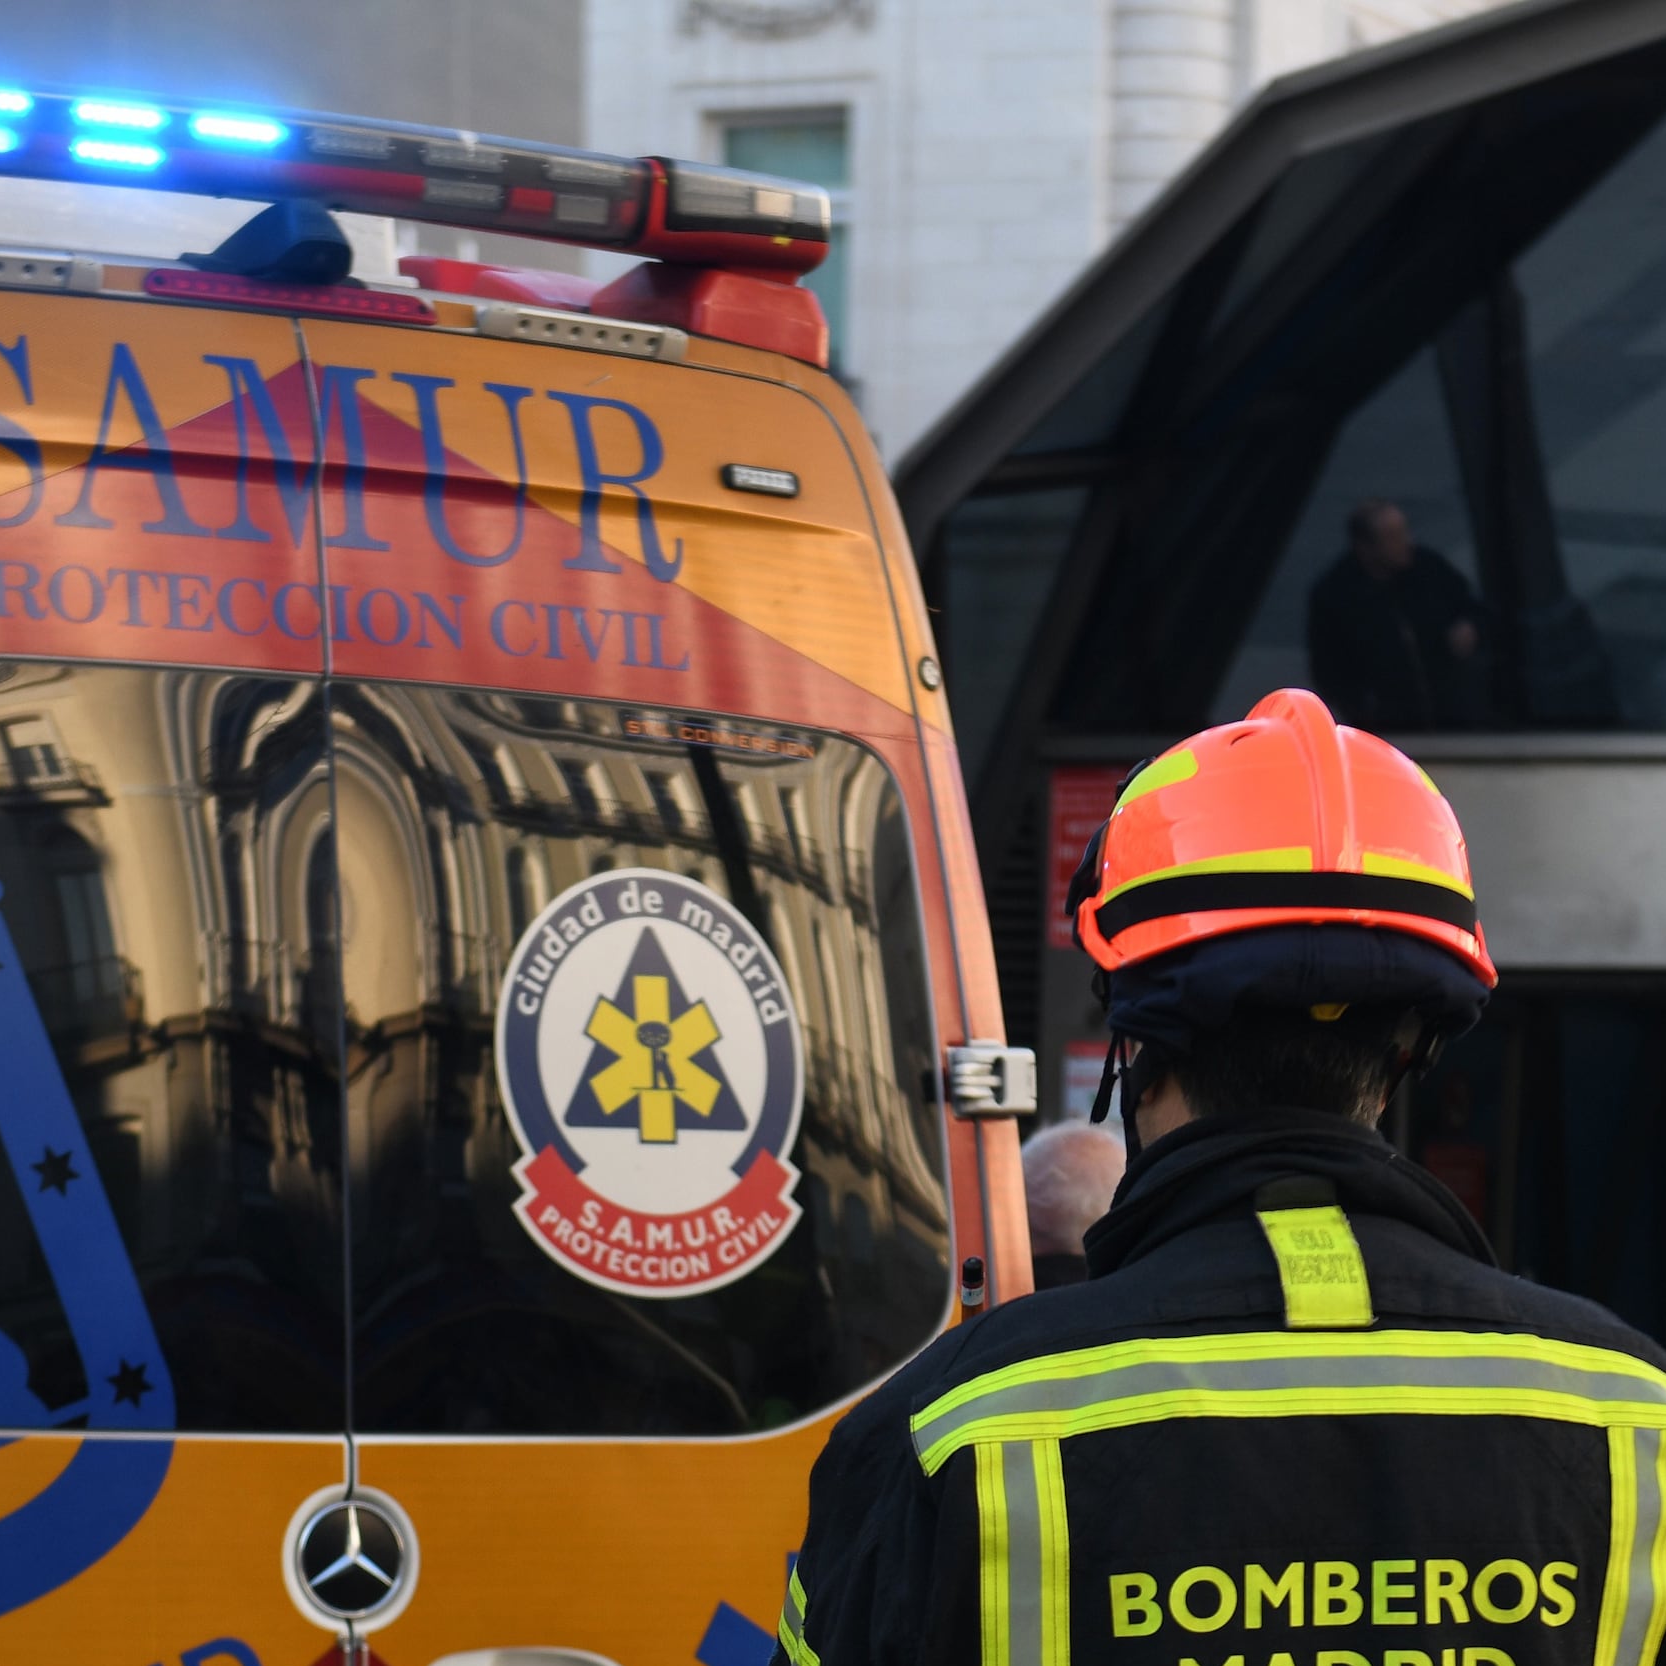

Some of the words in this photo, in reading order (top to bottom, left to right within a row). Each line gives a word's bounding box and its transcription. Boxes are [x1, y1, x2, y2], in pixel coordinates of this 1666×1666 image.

[490, 601, 690, 672] CIVIL
[516, 892, 604, 1016] ciudad
[617, 881, 663, 915] de
[679, 898, 788, 1026] madrid
[539, 1205, 711, 1281] PROTECCION
[717, 1210, 782, 1268] CIVIL
[578, 1199, 745, 1251] S.A.M.U.R.
[1109, 1558, 1578, 1638] BOMBEROS
